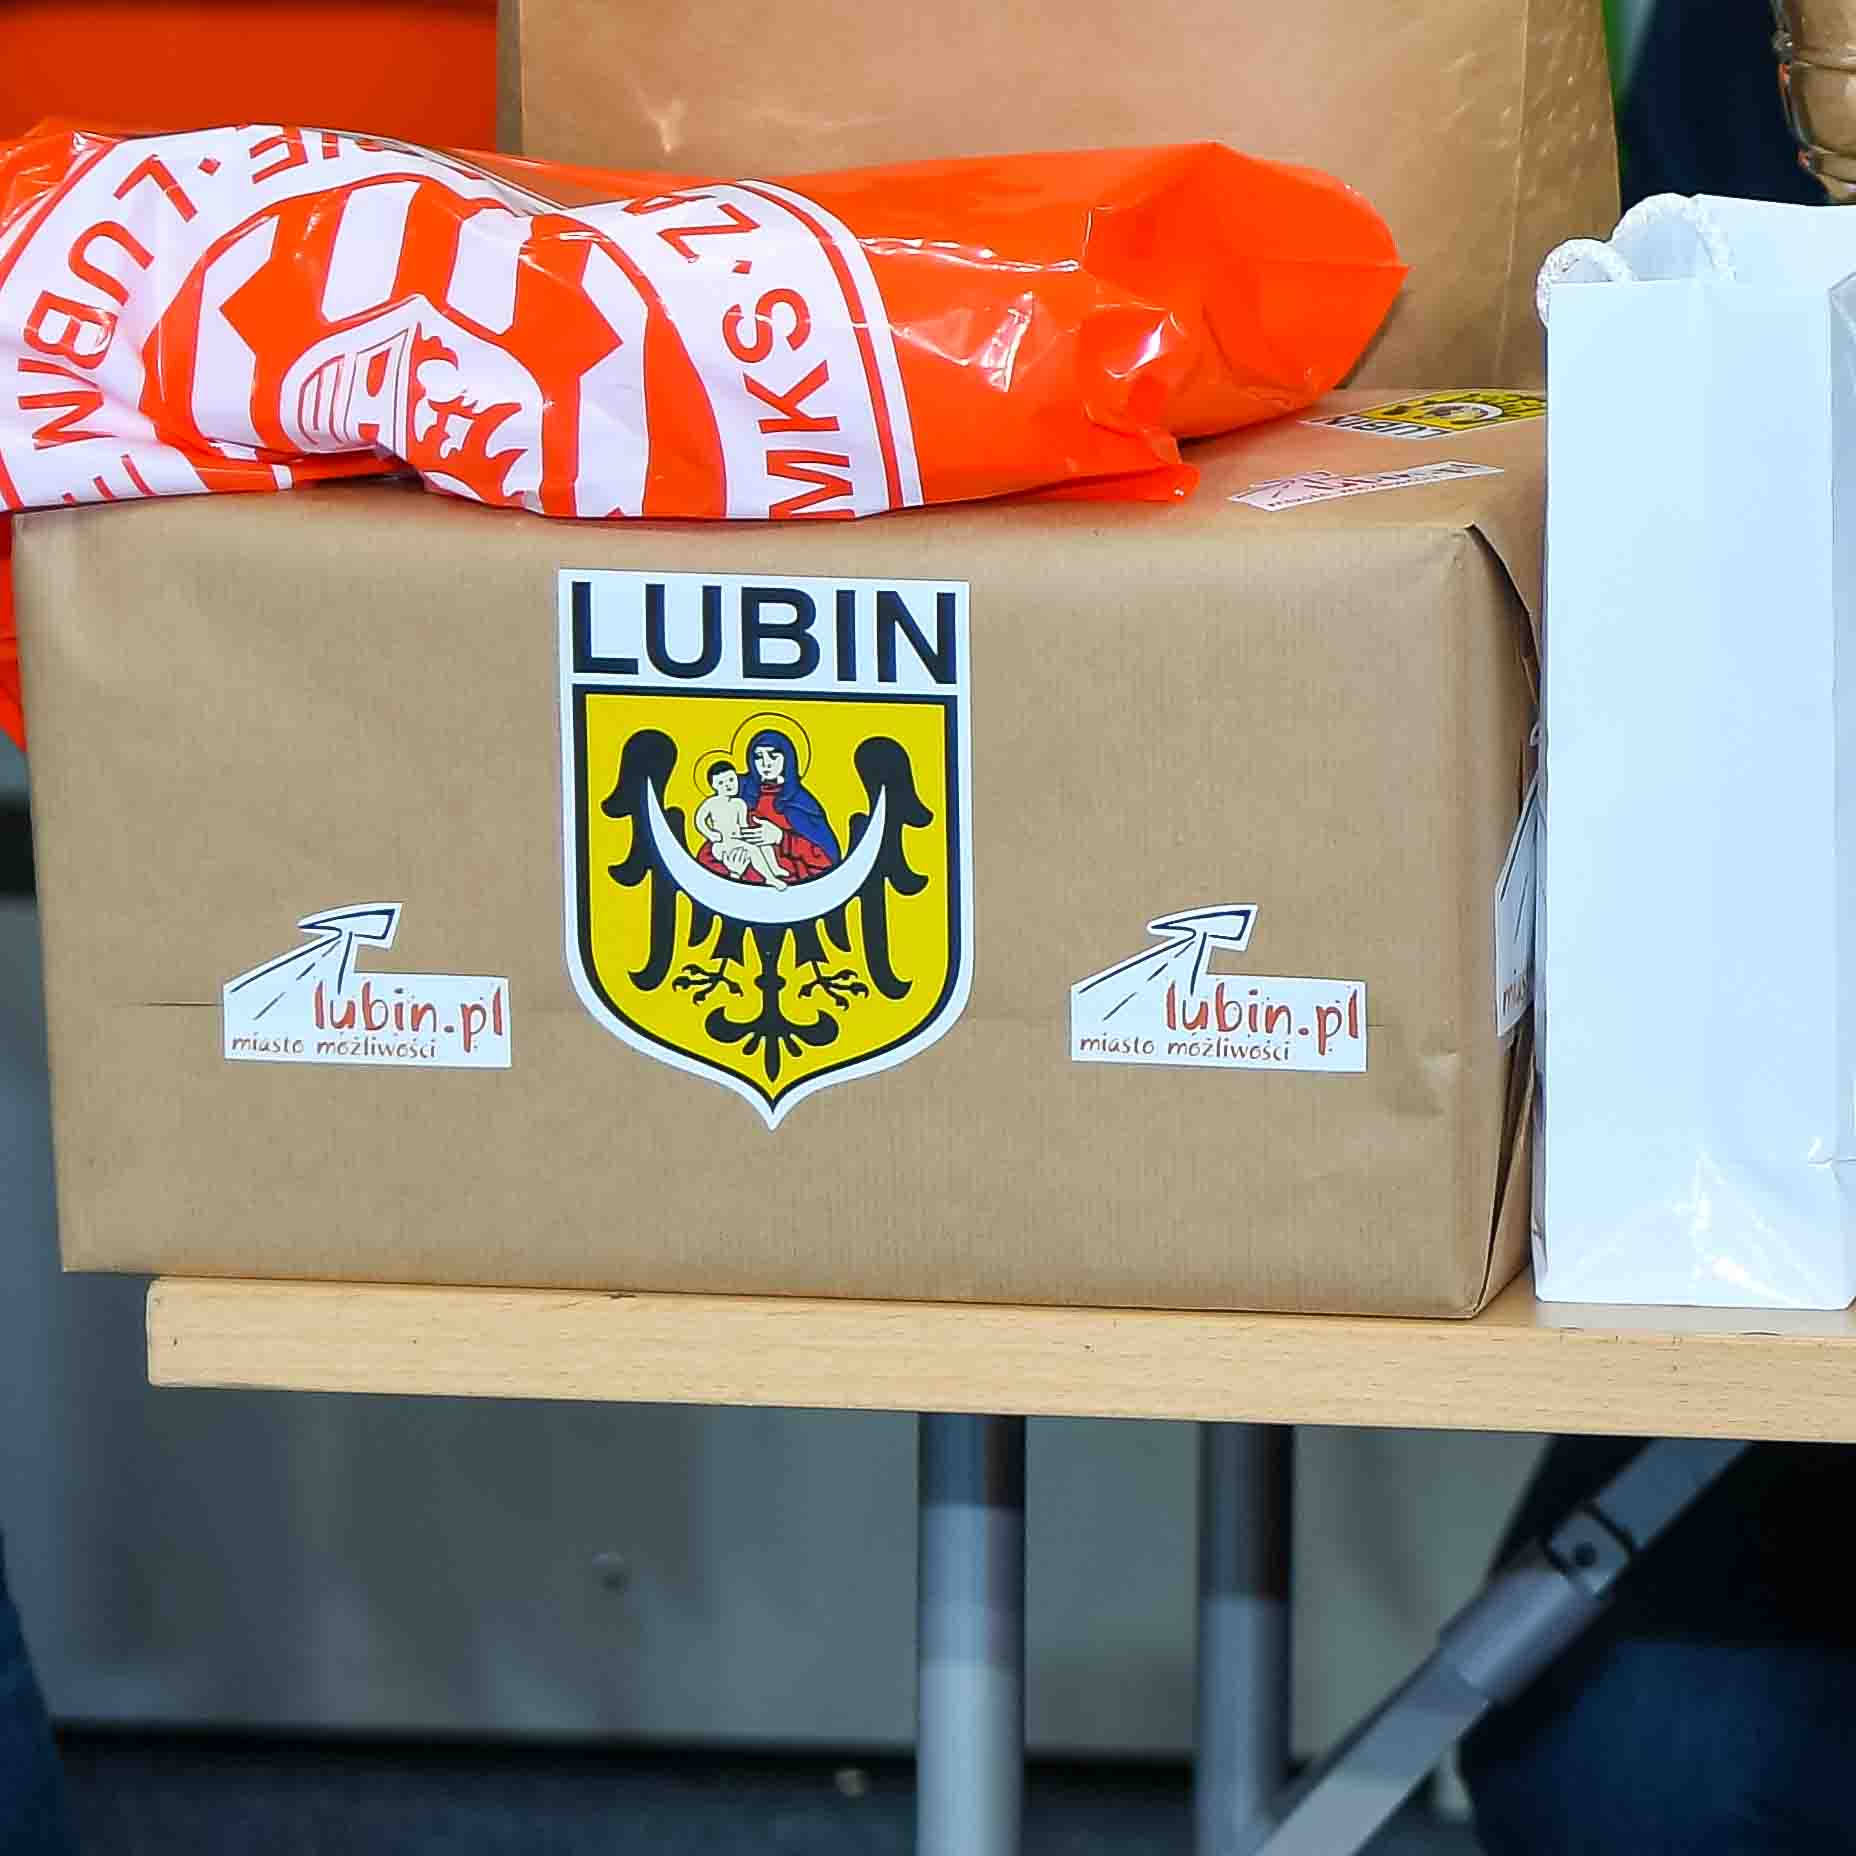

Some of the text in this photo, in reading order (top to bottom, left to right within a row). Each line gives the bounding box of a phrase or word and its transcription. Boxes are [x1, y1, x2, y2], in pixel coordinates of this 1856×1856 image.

[17, 154, 198, 450] LUBIN
[721, 287, 857, 520] MKS
[571, 580, 958, 685] LUBIN
[231, 1032, 437, 1059] miasto możliwości
[313, 980, 504, 1054] lubin.pl
[1079, 1032, 1290, 1062] miasto możliwości
[1166, 980, 1360, 1056] lubin.pl
